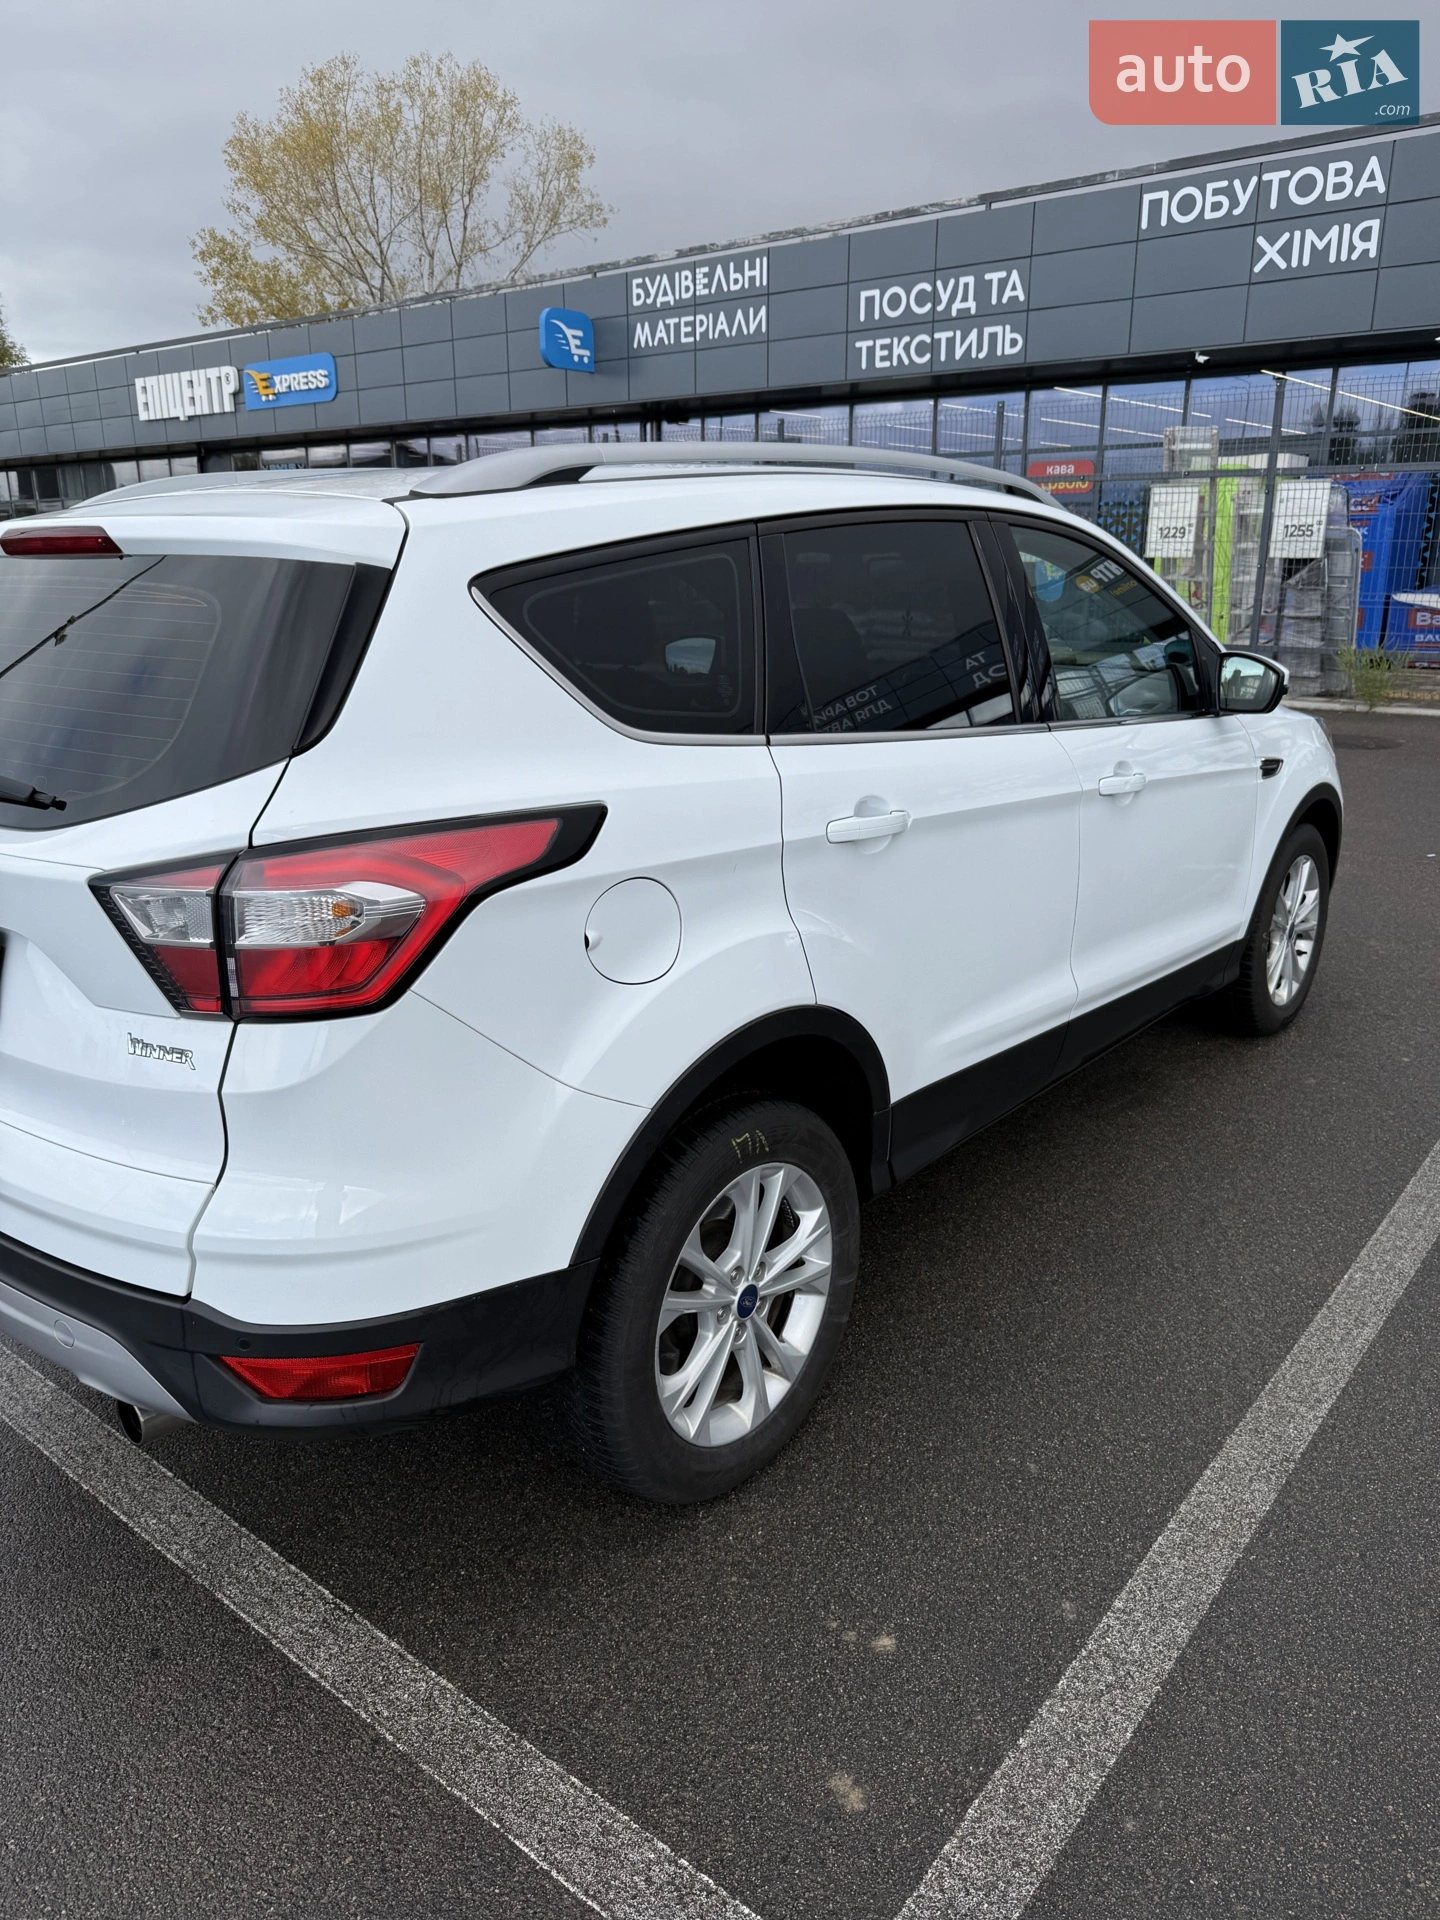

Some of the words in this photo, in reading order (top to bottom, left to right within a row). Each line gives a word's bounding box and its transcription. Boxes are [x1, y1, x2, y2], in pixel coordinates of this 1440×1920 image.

[1141, 155, 1386, 230] ПОБУТОВА
[1253, 219, 1380, 273] ХІМІЯ
[632, 256, 768, 308] БУДІВЕЛЬНІ
[859, 275, 976, 323] ПОСУД
[984, 269, 1025, 306] ТА
[633, 305, 767, 349] МАТЕРІАЛИ
[855, 324, 1023, 370] ТЕКСТИЛЬ
[135, 366, 239, 421] ЕПІЦЕНТР
[1158, 526, 1186, 539] 1229
[1283, 524, 1314, 538] 1255
[127, 1032, 196, 1070] WINNER
